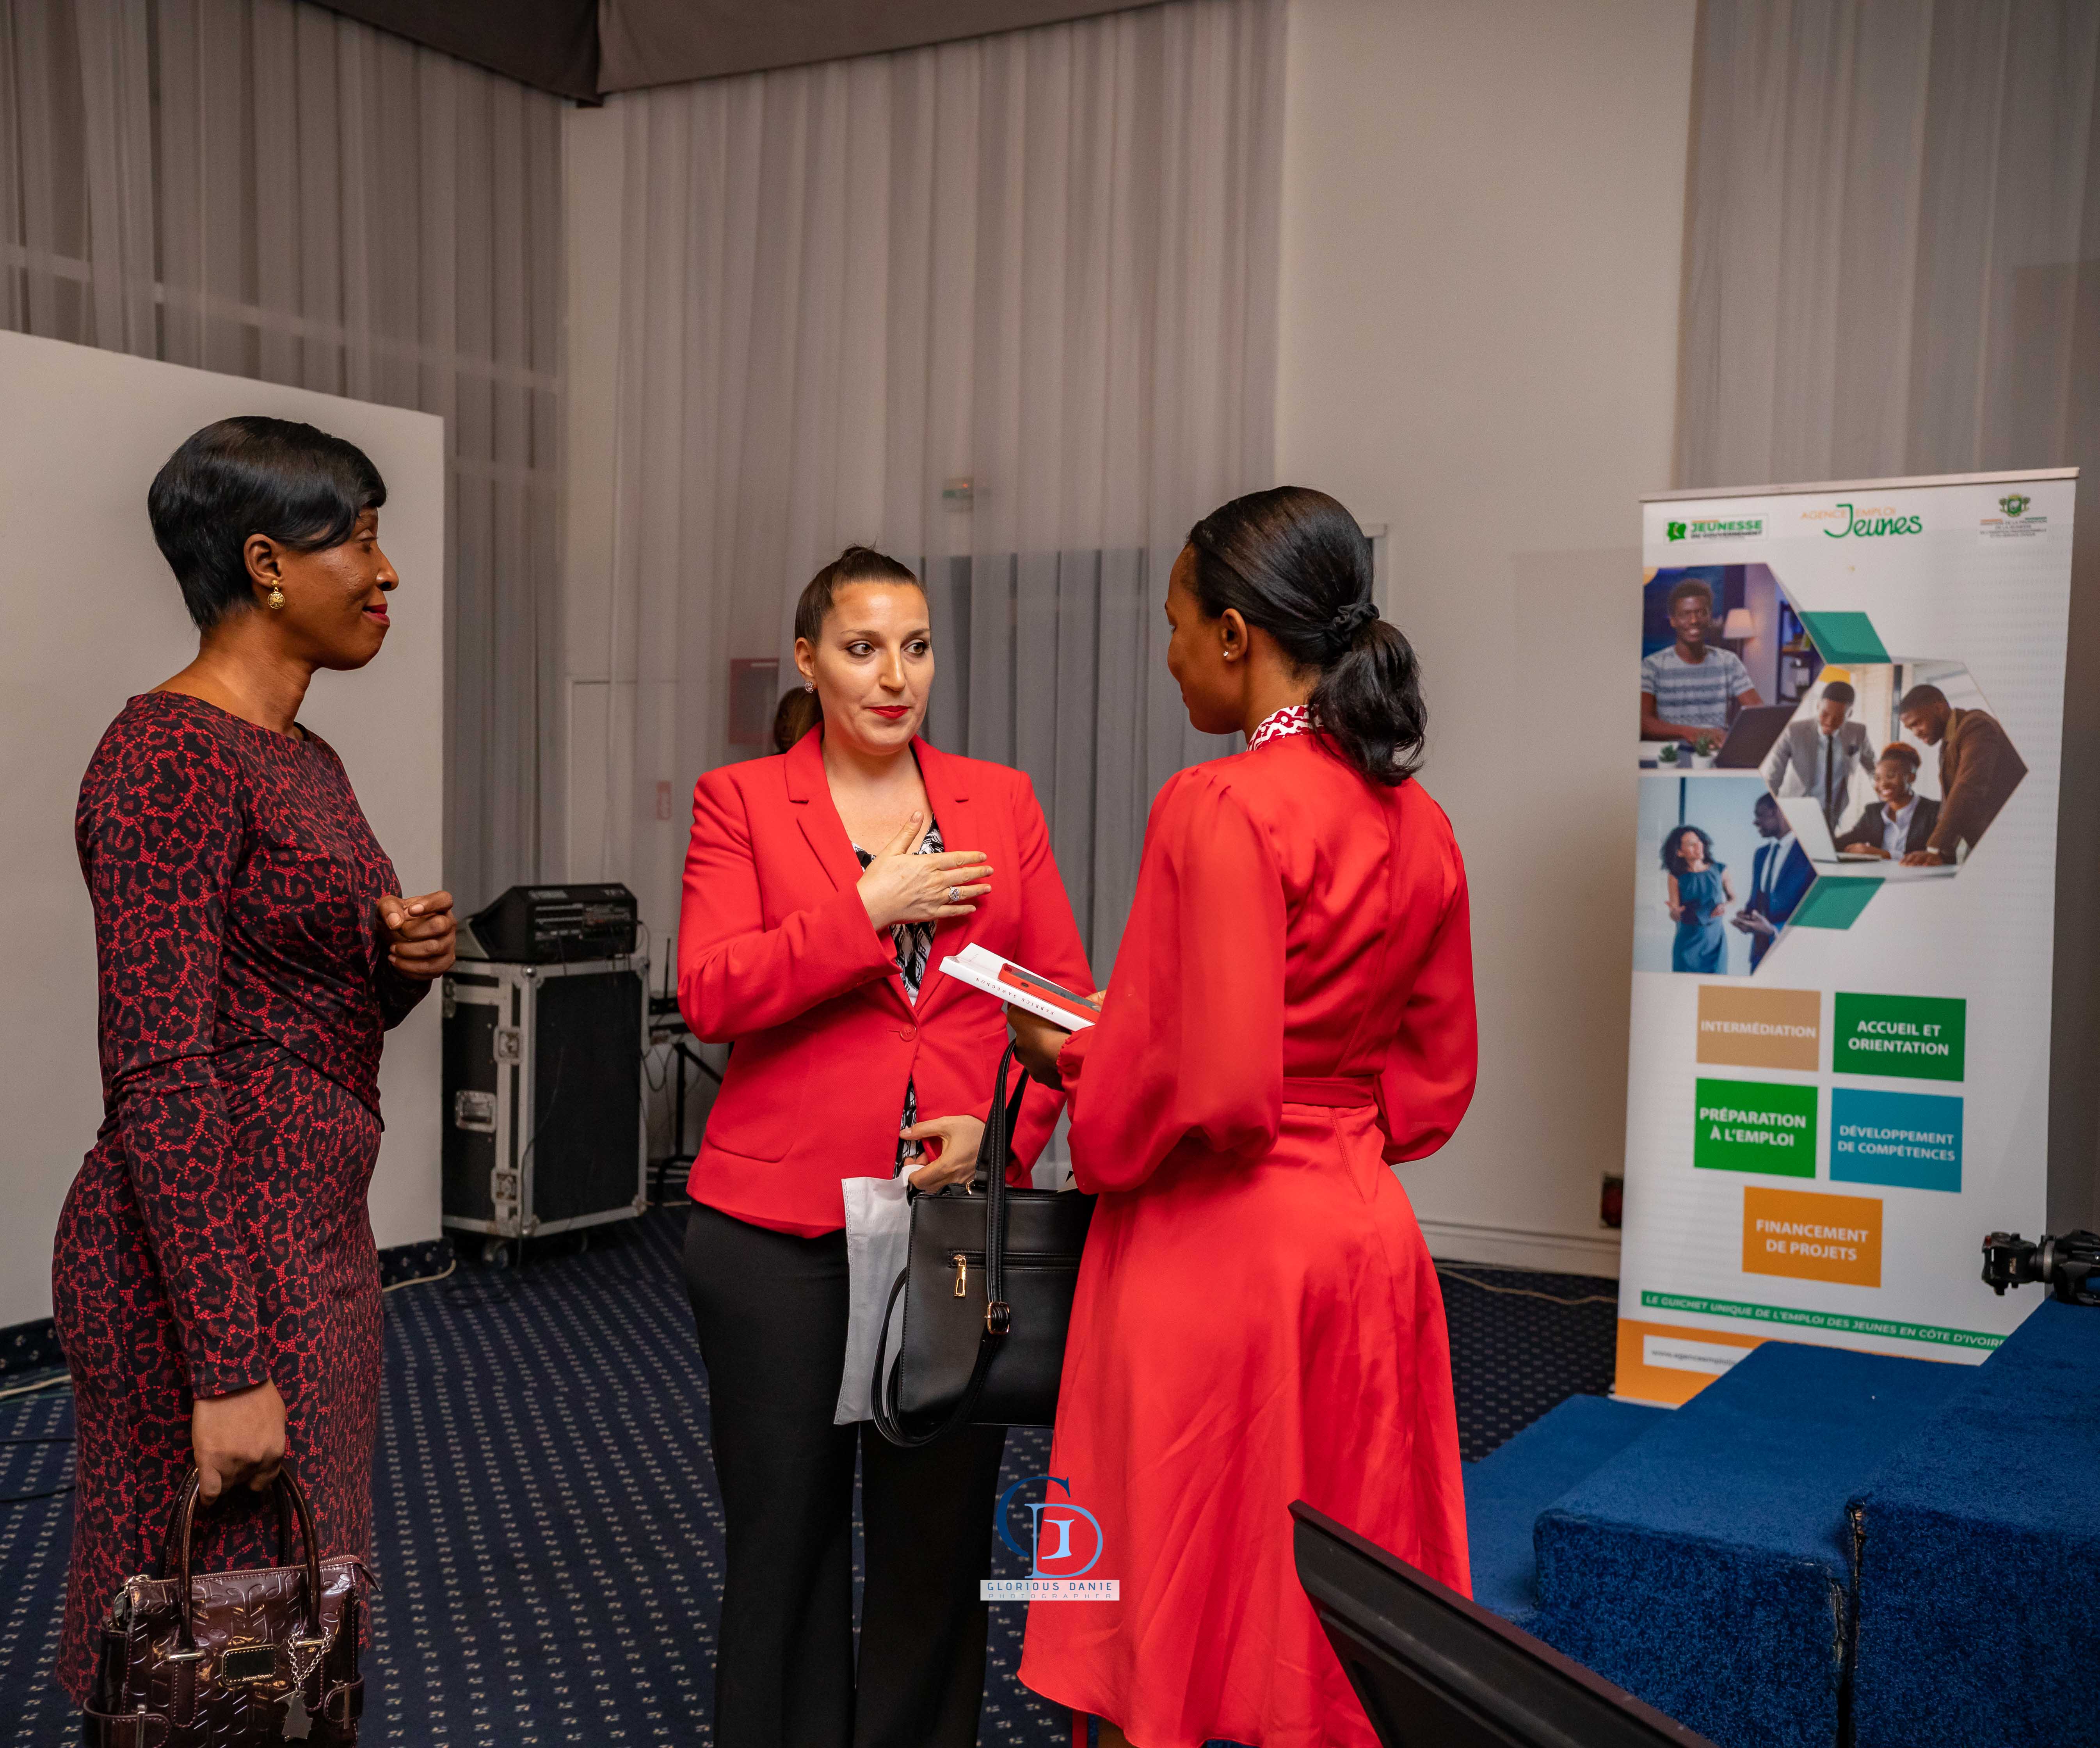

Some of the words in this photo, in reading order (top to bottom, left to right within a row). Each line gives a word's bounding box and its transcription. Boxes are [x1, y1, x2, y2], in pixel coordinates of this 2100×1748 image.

[1800, 509, 1846, 519] AGENCE
[1855, 506, 1897, 517] EMPLOI
[1824, 503, 1922, 538] Jeunes
[1691, 520, 1762, 532] JEUNESSE
[975, 977, 1017, 998] SAWEGNON
[1021, 997, 1054, 1015] FABRICE
[1700, 1020, 1817, 1039] INTERMÉDIATION
[1857, 1020, 1920, 1036] ACCUEIL
[1923, 1024, 1942, 1037] ET
[1848, 1037, 1949, 1056] ORIENTATION
[1699, 1106, 1807, 1128] PRÉPARATION
[1724, 1128, 1795, 1147] L'EMPLOI
[1839, 1124, 1954, 1145] DÉVELOPPEMENT
[1837, 1140, 1855, 1153] DE
[1858, 1142, 1955, 1162] COMPÉTENCES
[1756, 1219, 1869, 1243] FINANCEMENT
[1766, 1239, 1787, 1254] DE
[1790, 1242, 1858, 1261] PROJETS
[1646, 1295, 1658, 1305] LE
[1661, 1296, 1708, 1310] GUICHET
[1710, 1302, 1752, 1316] UNIQUE
[1755, 1308, 1771, 1319] DE
[1773, 1310, 1824, 1325] L'EMPLOI
[1827, 1316, 1849, 1329] DES
[1852, 1320, 1897, 1334] JEUNES
[1899, 1326, 1916, 1337] EN
[1919, 1328, 1950, 1341] CÔTE
